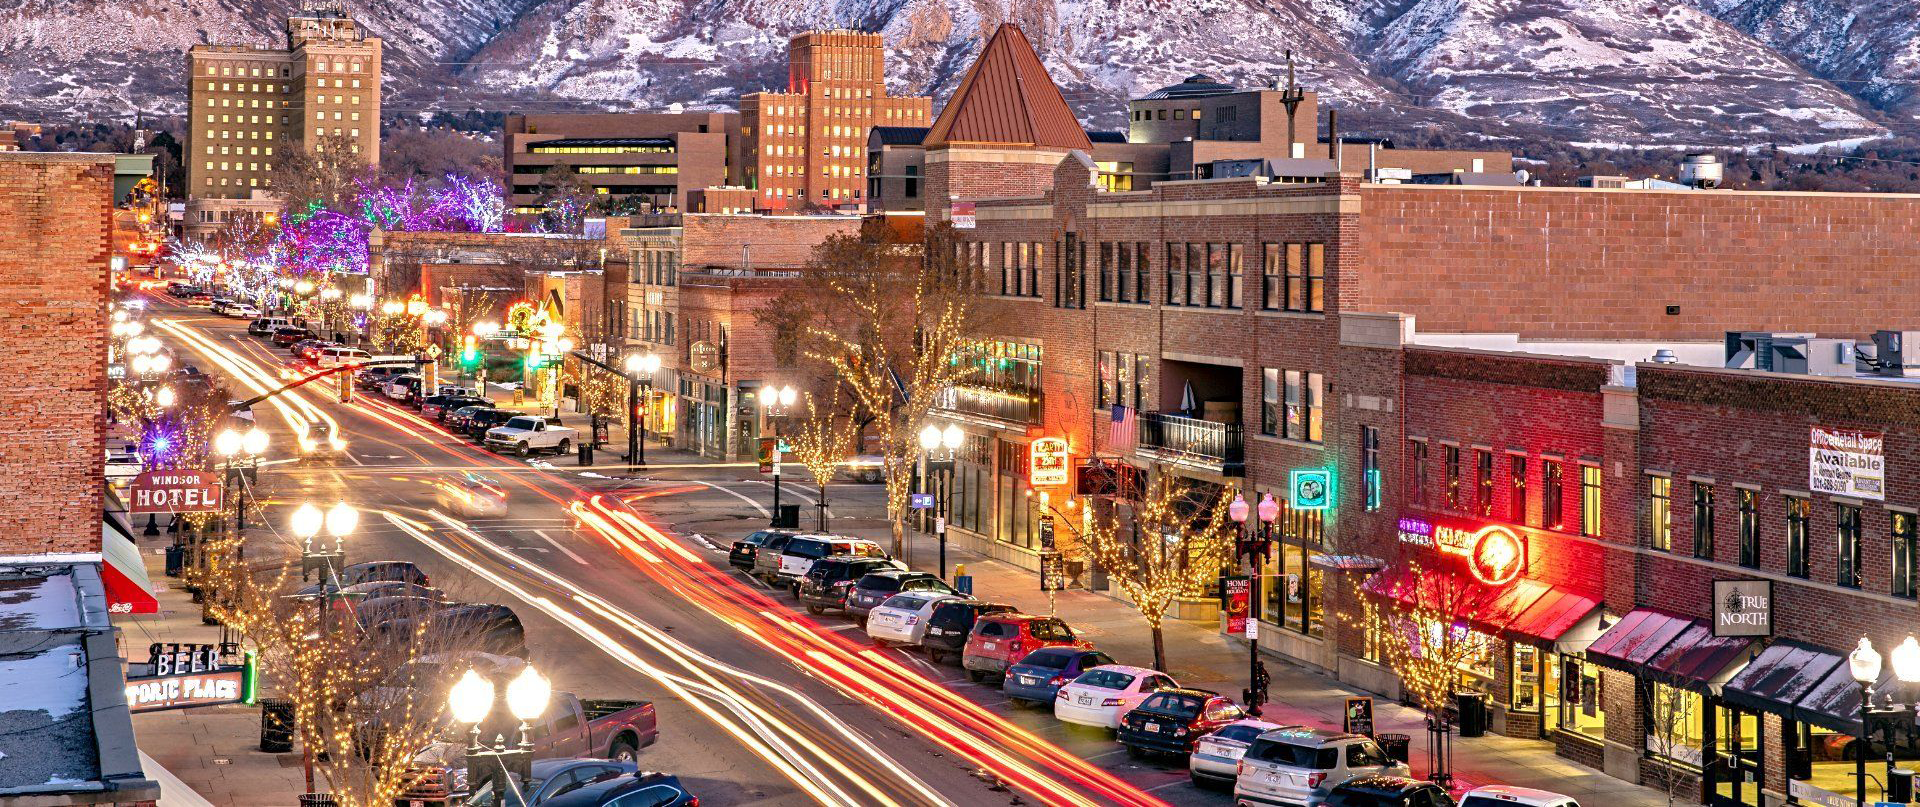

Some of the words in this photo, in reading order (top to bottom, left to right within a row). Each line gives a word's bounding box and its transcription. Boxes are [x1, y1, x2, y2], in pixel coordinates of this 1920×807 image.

[1858, 434, 1882, 454] Space
[1814, 450, 1880, 470] Available
[151, 475, 201, 485] WINDSOR
[136, 488, 216, 506] HOTEL
[1739, 595, 1768, 609] TRUE
[1720, 612, 1768, 626] NORTH
[157, 650, 220, 676] BEER
[183, 679, 237, 699] PLACE
